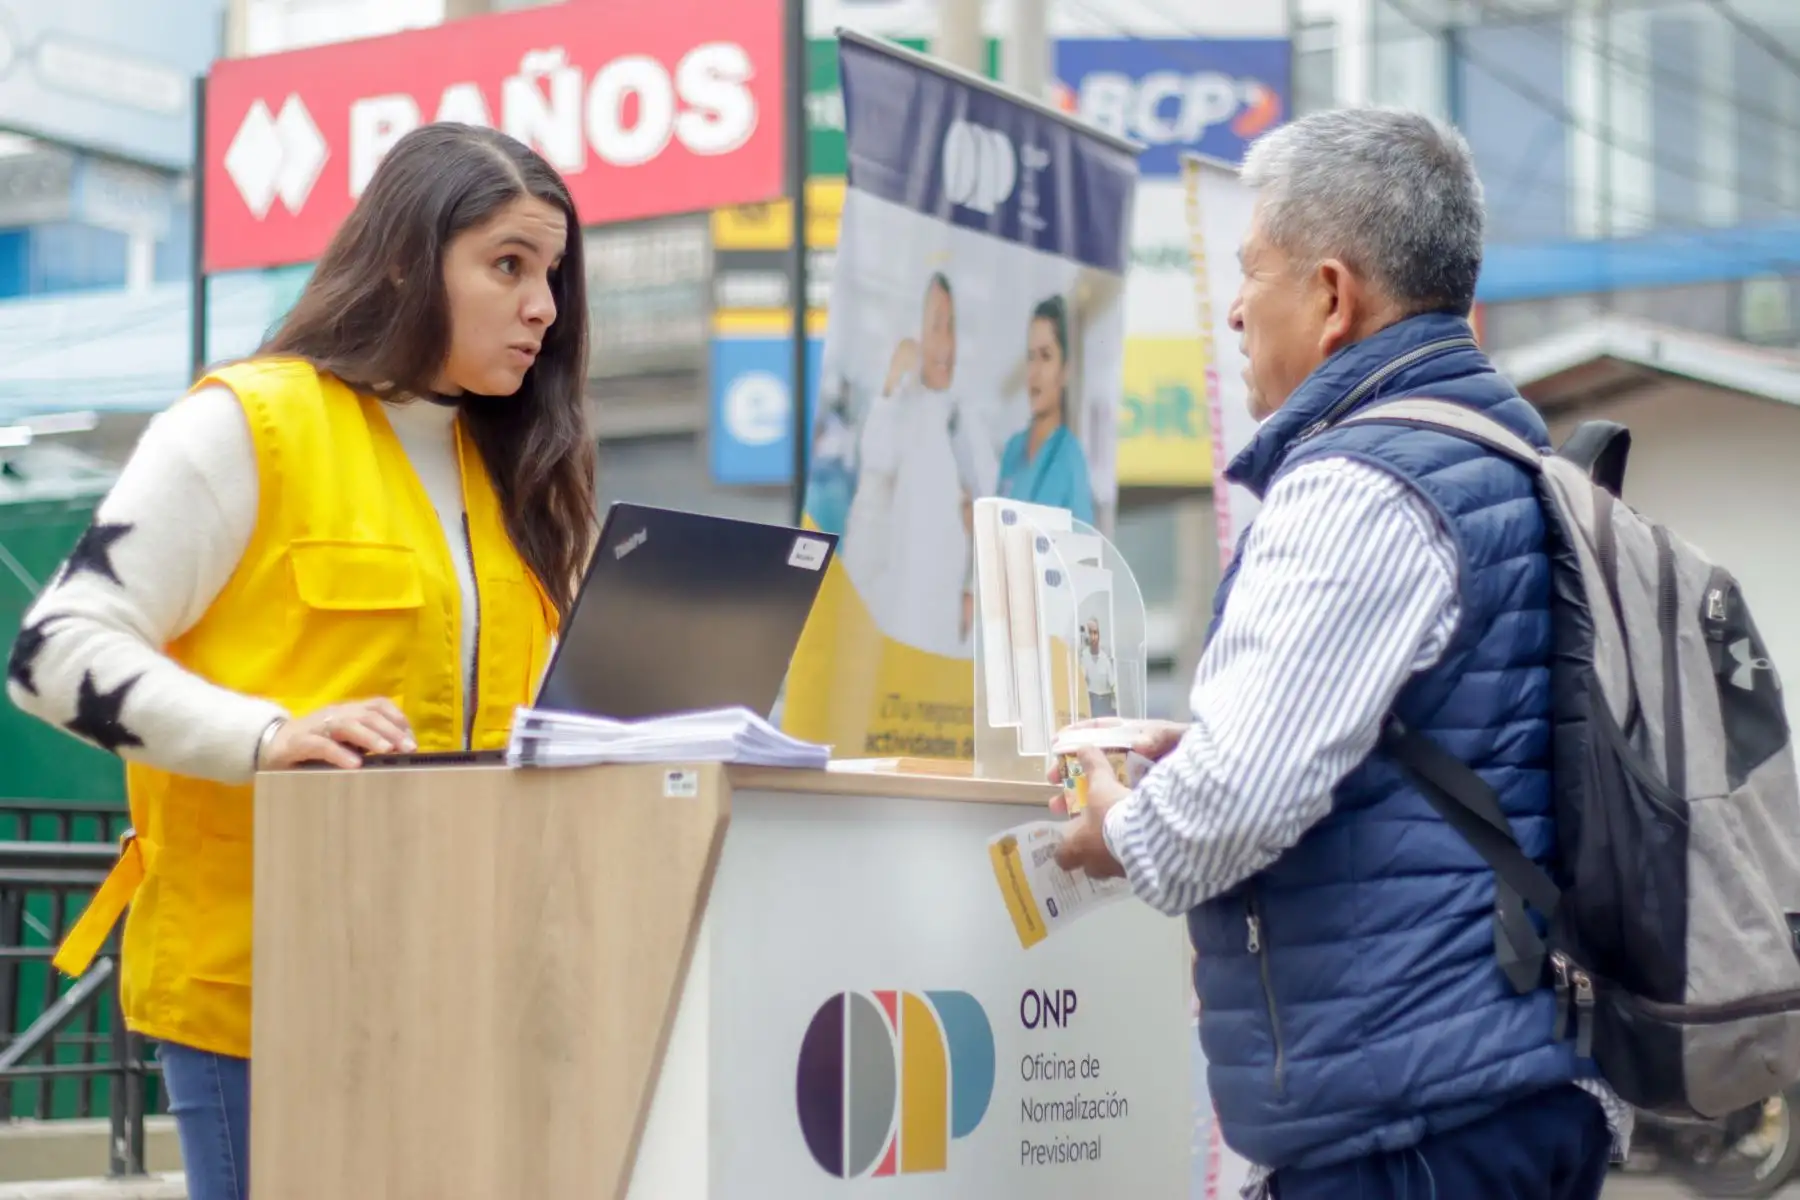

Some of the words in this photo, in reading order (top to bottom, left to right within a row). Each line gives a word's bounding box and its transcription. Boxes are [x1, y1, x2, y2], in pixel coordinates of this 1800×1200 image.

[1080, 71, 1238, 146] BCP
[1020, 989, 1077, 1029] ONP
[1021, 1052, 1076, 1082] Oficina
[1080, 1054, 1100, 1079] de
[1021, 1090, 1128, 1123] Normalización
[1021, 1134, 1101, 1166] Previsional
